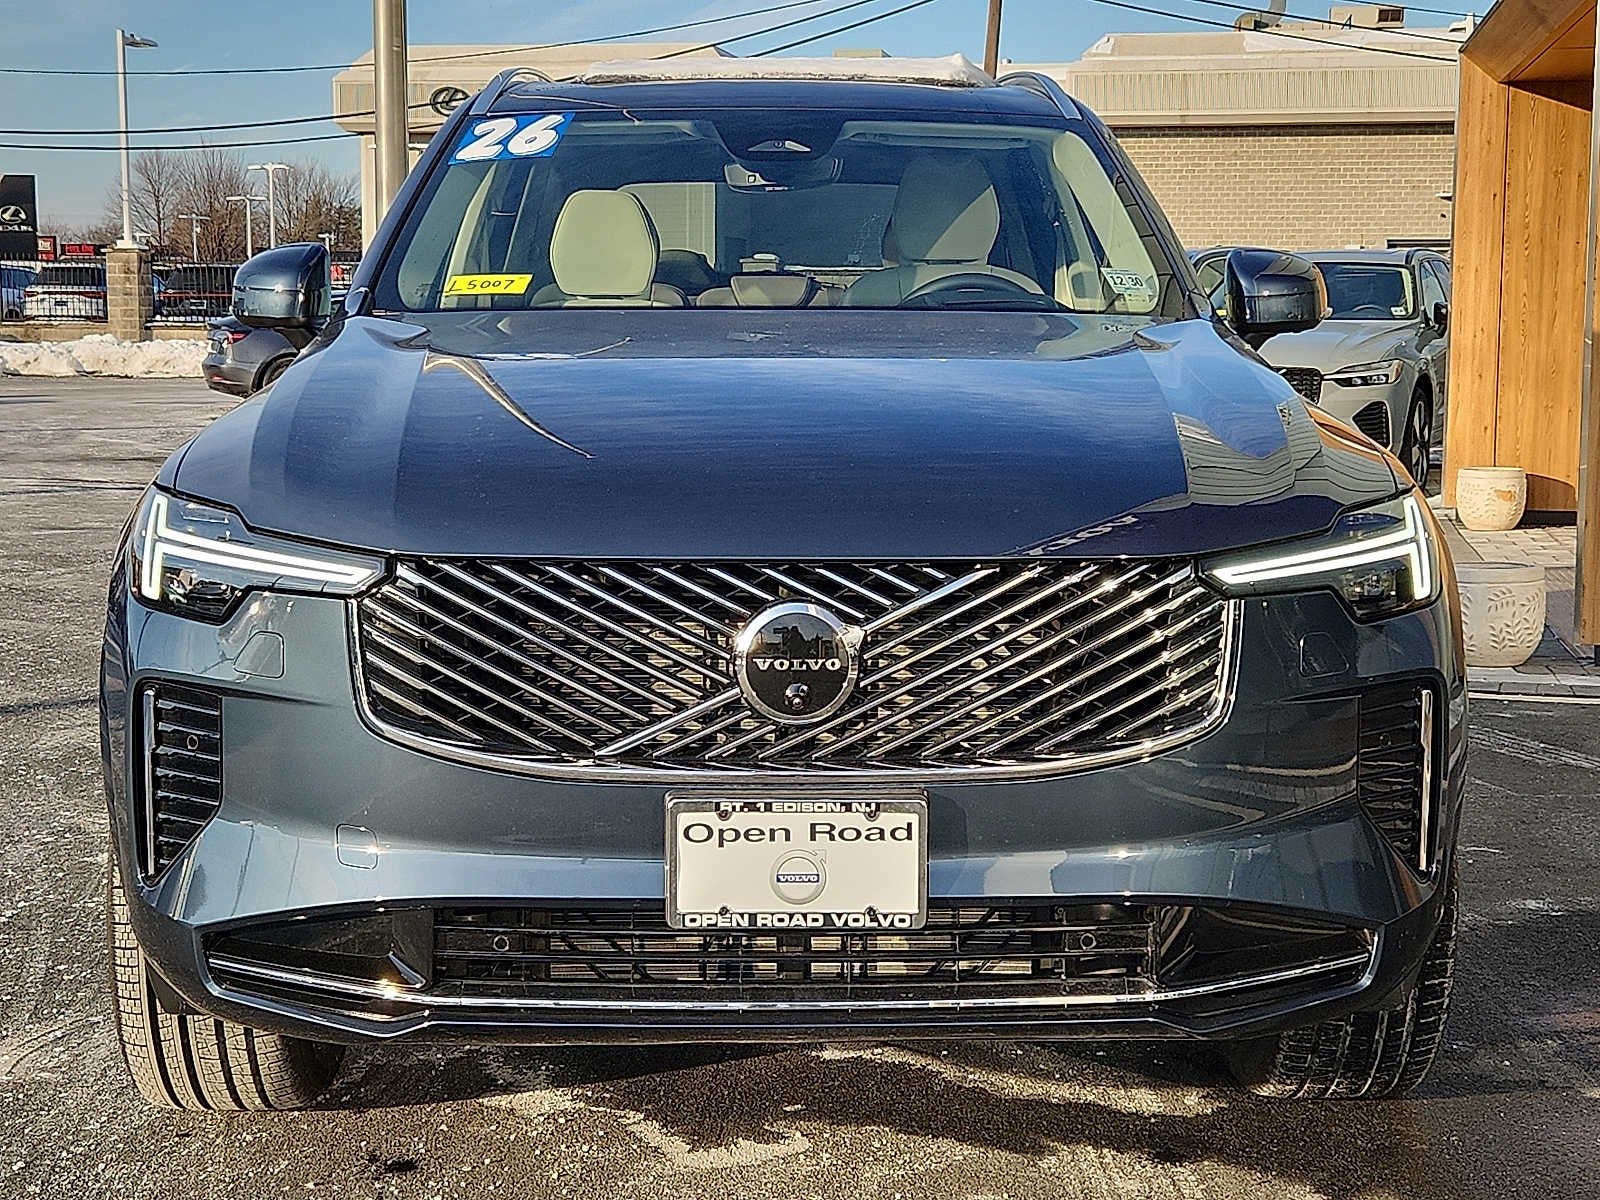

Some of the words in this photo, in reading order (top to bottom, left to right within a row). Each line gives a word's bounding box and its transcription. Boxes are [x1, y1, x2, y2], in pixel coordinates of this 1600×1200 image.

[455, 114, 565, 160] 26
[752, 658, 842, 671] VOLVO
[719, 801, 749, 813] RT.
[755, 802, 765, 813] 1
[771, 802, 846, 813] EDISON,
[851, 802, 876, 813] NJ
[683, 822, 791, 847] Open
[809, 822, 913, 842] Road
[777, 875, 819, 883] VOLVO
[684, 913, 750, 928] OPEN
[756, 913, 824, 928] ROAD
[831, 913, 911, 928] VOLVO
